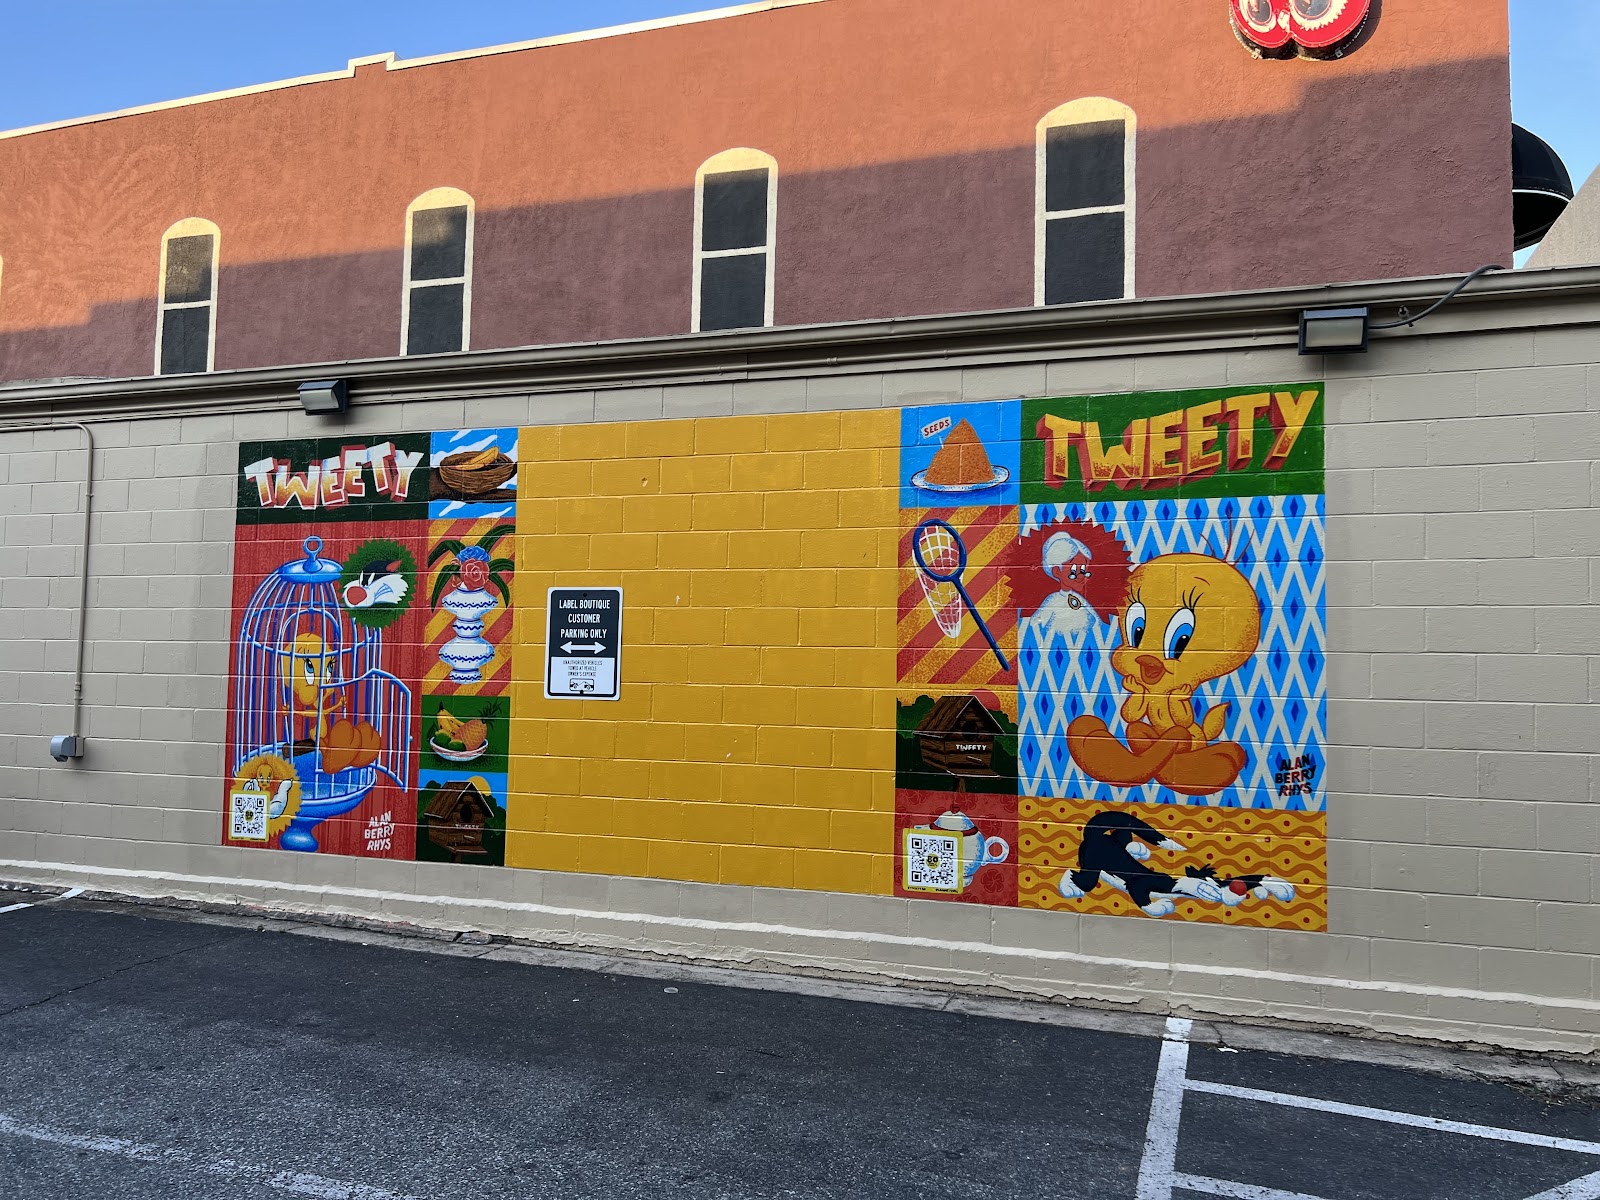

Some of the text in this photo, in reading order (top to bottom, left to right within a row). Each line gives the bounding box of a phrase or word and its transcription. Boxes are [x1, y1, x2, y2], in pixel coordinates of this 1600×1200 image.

[923, 419, 950, 437] SEEDS
[1037, 391, 1319, 491] TWEETY
[243, 441, 425, 510] TWEETY
[559, 599, 611, 610] LABEL BOUTIQUE
[568, 613, 601, 623] CUSTOMER
[560, 628, 607, 639] PARKING ONLY
[1279, 753, 1311, 771] ALAN
[1275, 765, 1316, 784] BERRY
[1279, 782, 1312, 797] RHYS
[369, 810, 391, 827] ALAN
[365, 823, 395, 839] BERRY
[367, 838, 391, 851] RHYS
